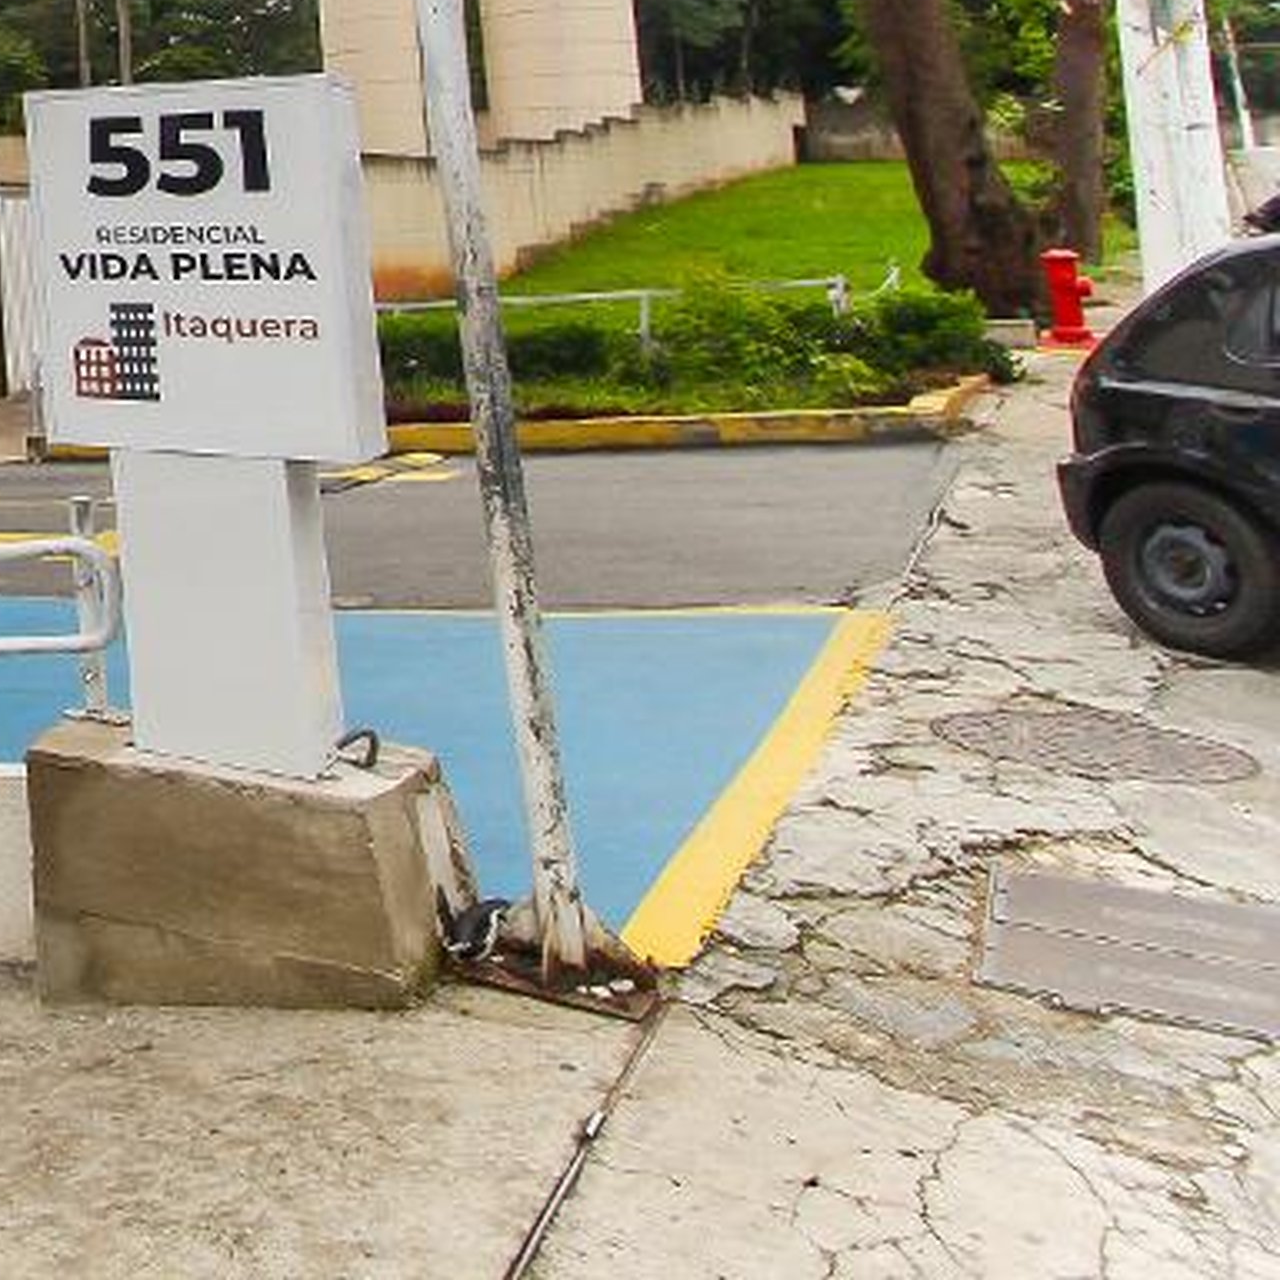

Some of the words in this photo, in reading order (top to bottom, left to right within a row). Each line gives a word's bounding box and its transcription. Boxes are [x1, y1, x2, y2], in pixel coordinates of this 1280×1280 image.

[86, 109, 271, 198] 551
[96, 225, 266, 245] RESIDENCIAL
[59, 253, 160, 281] VIDA
[171, 252, 317, 282] PLENA
[163, 311, 320, 343] Itaquera
